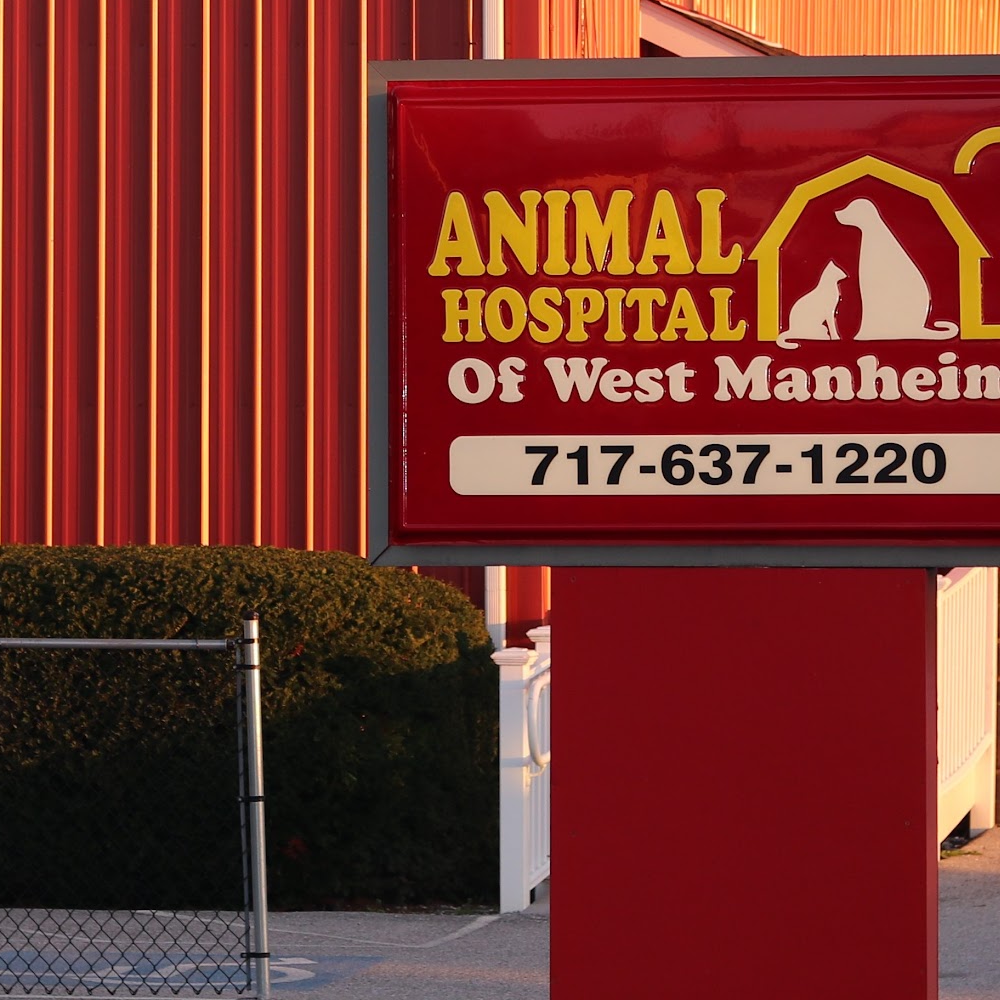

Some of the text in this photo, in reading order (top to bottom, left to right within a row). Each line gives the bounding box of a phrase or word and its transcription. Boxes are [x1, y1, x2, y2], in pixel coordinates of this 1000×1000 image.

[428, 189, 742, 276] ANIMAL
[441, 286, 747, 343] HOSPITAL
[447, 357, 526, 404] Of
[544, 356, 695, 402] West
[524, 442, 947, 486] 717-637-1220
